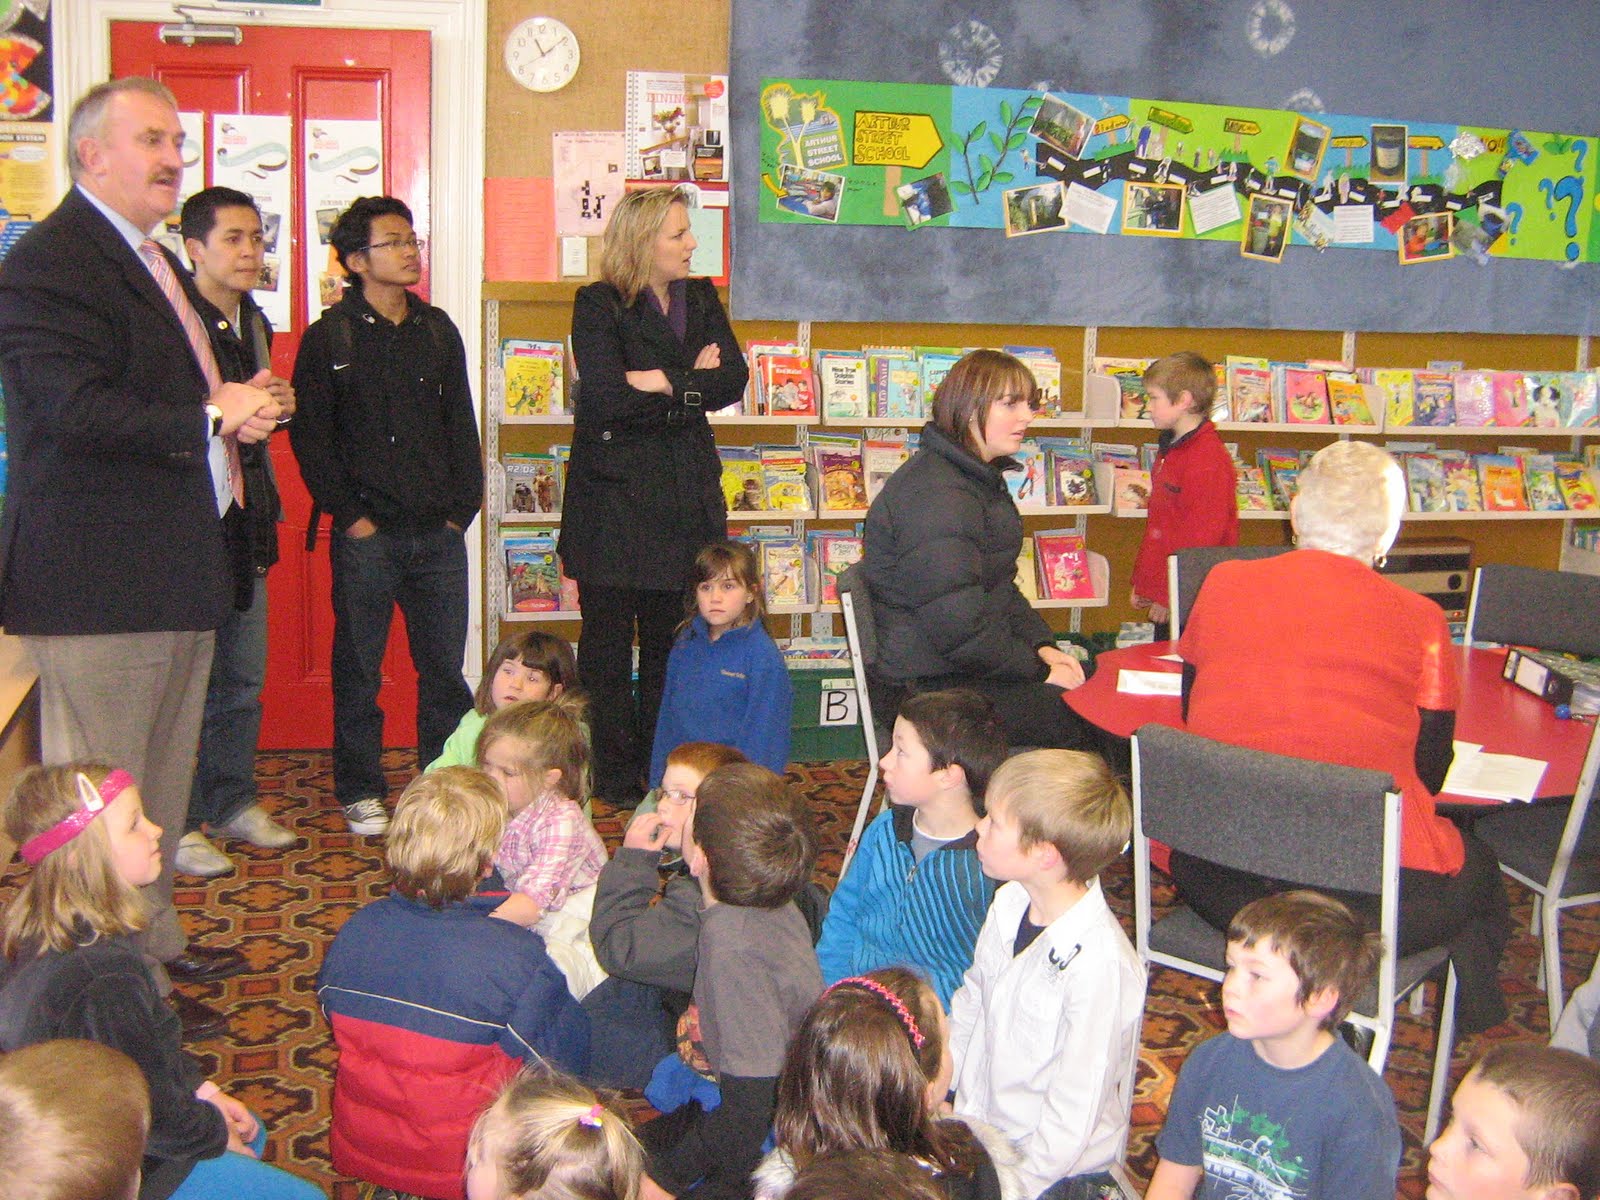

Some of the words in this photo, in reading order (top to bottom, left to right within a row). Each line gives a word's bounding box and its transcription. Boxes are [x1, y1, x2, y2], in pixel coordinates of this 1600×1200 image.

[804, 135, 838, 147] ARTHUR
[855, 131, 904, 145] STREET
[806, 145, 839, 157] STREET
[854, 144, 911, 163] SCHOOL
[807, 153, 842, 167] SCHOOL
[826, 691, 849, 721] B
